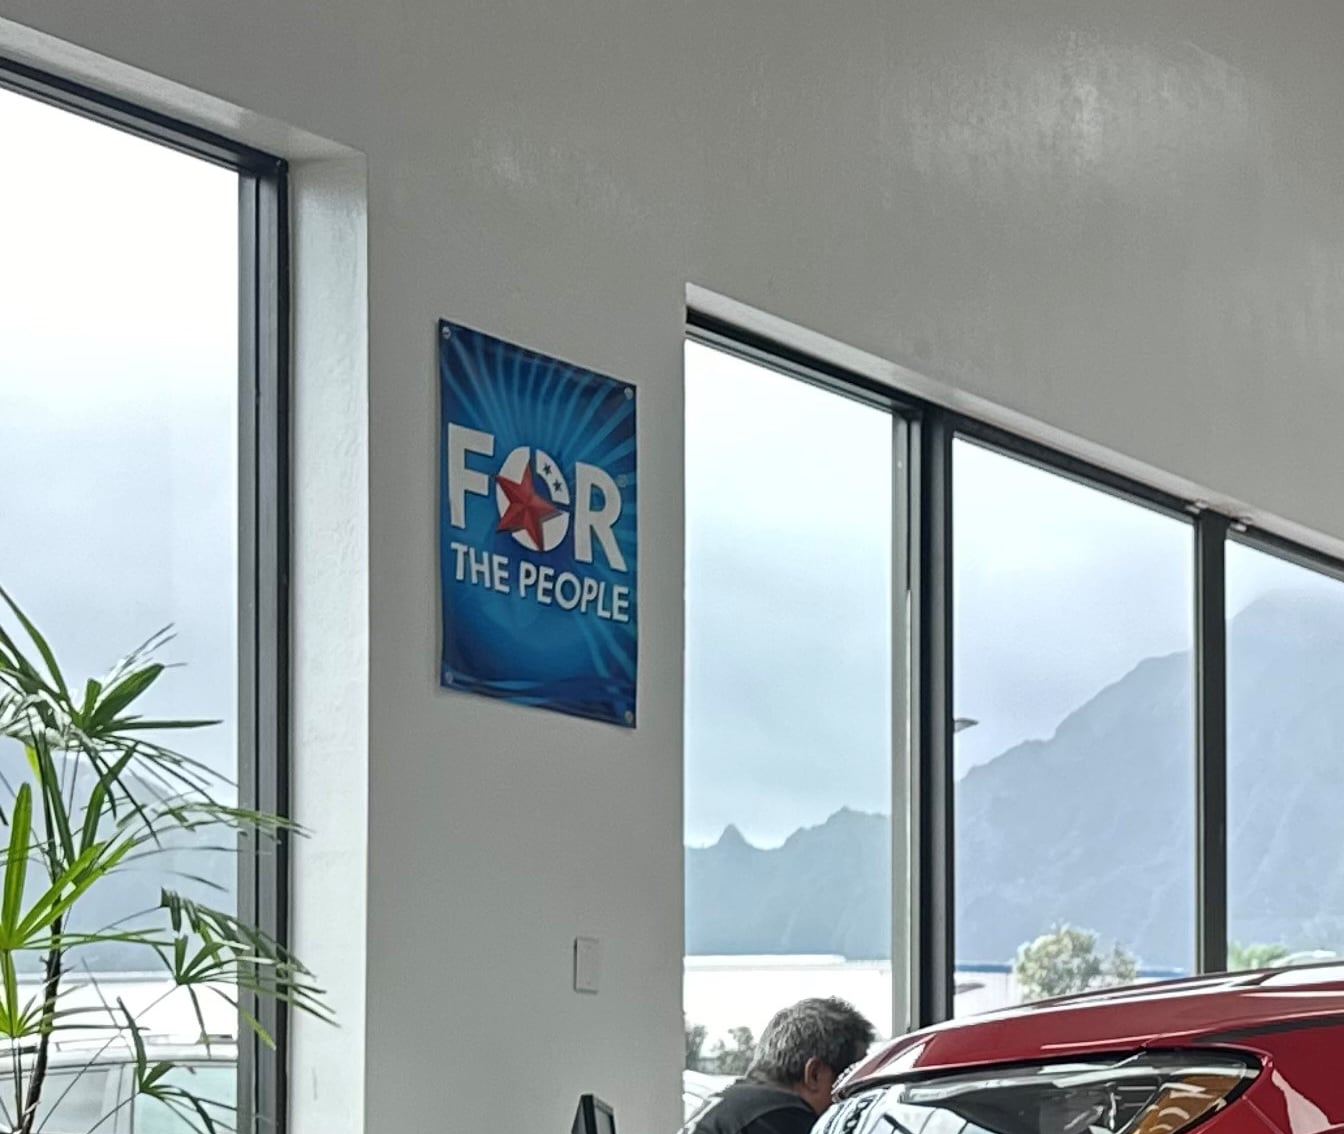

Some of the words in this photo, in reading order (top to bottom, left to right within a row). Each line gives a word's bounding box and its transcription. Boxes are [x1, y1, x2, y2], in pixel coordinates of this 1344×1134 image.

[448, 422, 628, 572] FOR
[450, 542, 510, 594] THE
[519, 563, 630, 623] PEOPLE
